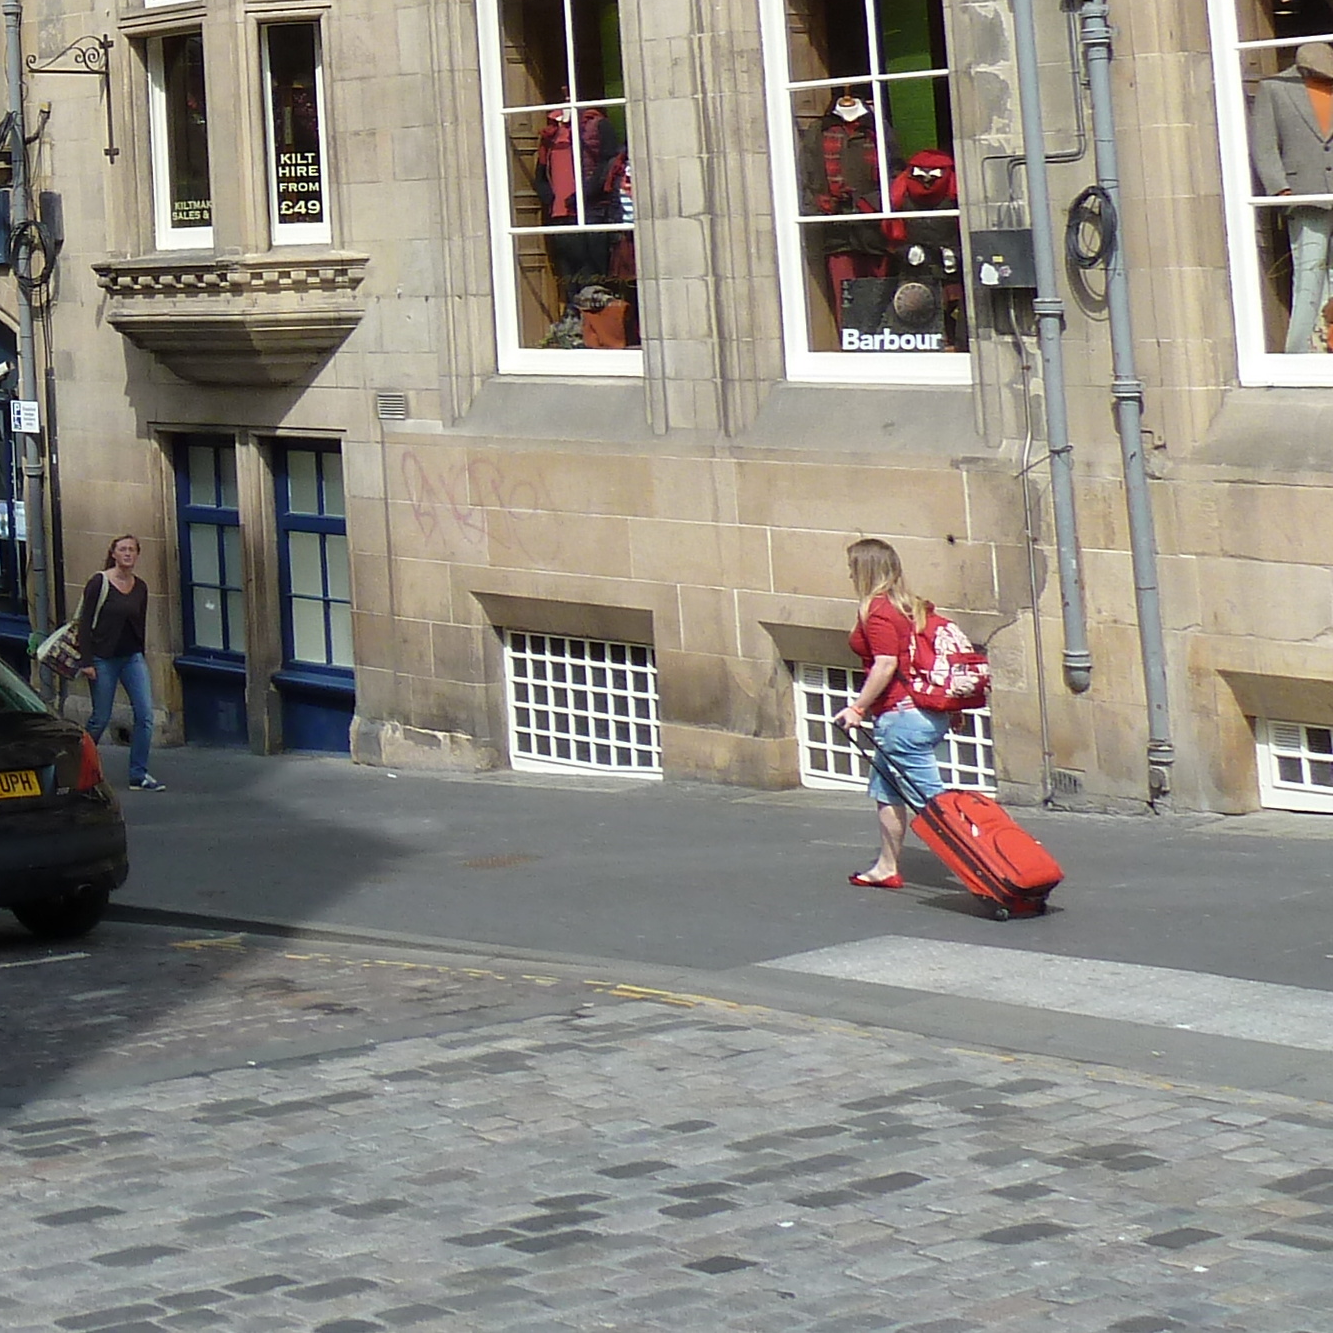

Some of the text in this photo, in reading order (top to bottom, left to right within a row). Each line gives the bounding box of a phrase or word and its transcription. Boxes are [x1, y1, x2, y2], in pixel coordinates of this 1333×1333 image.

[280, 152, 316, 164] KILT
[278, 166, 319, 177] HIRE
[279, 182, 319, 192] FROM
[280, 200, 320, 214] £49
[172, 211, 201, 220] SALES
[842, 328, 942, 350] Barbour
[0, 772, 33, 793] UPH
